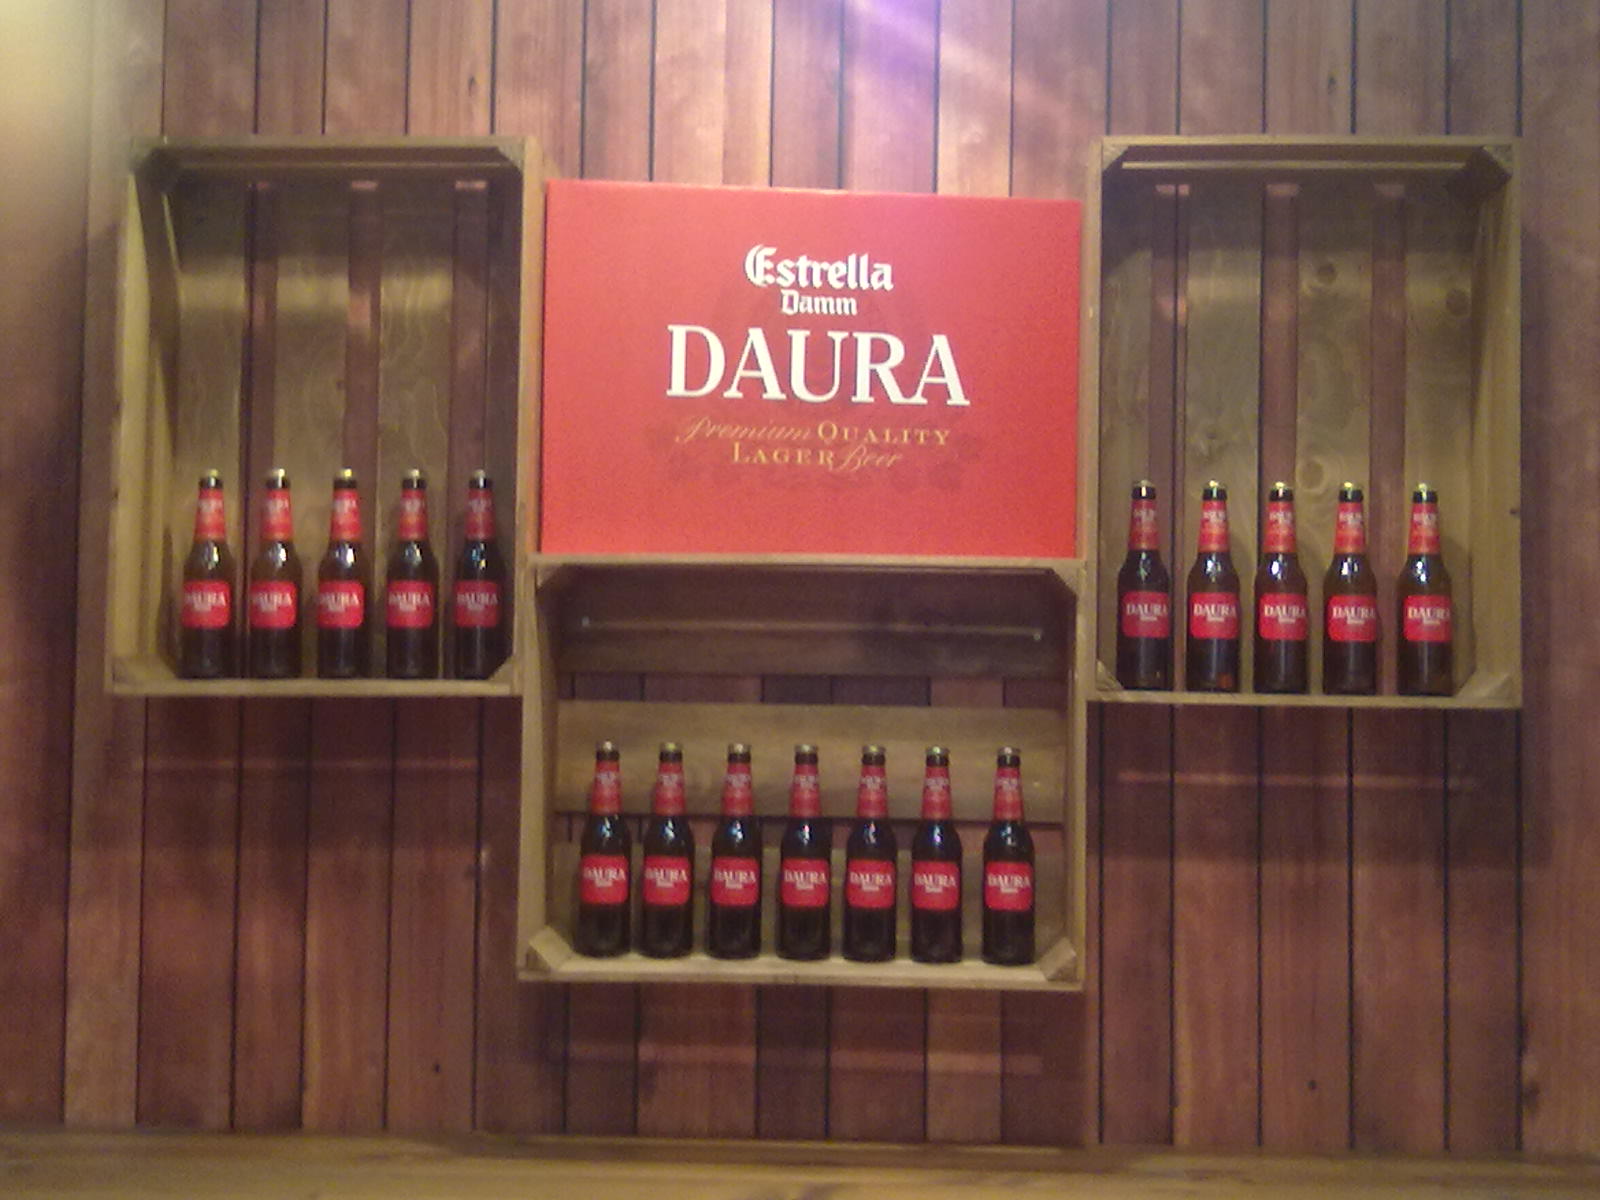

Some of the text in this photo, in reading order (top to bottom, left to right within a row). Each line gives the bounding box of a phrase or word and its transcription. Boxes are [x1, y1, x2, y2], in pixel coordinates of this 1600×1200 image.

[744, 244, 894, 291] Estrella
[780, 289, 857, 316] Damm
[666, 324, 970, 406] DAURA
[675, 414, 951, 446] Premium QUALITY
[732, 442, 835, 466] LAGER
[1193, 603, 1237, 617] DAURA
